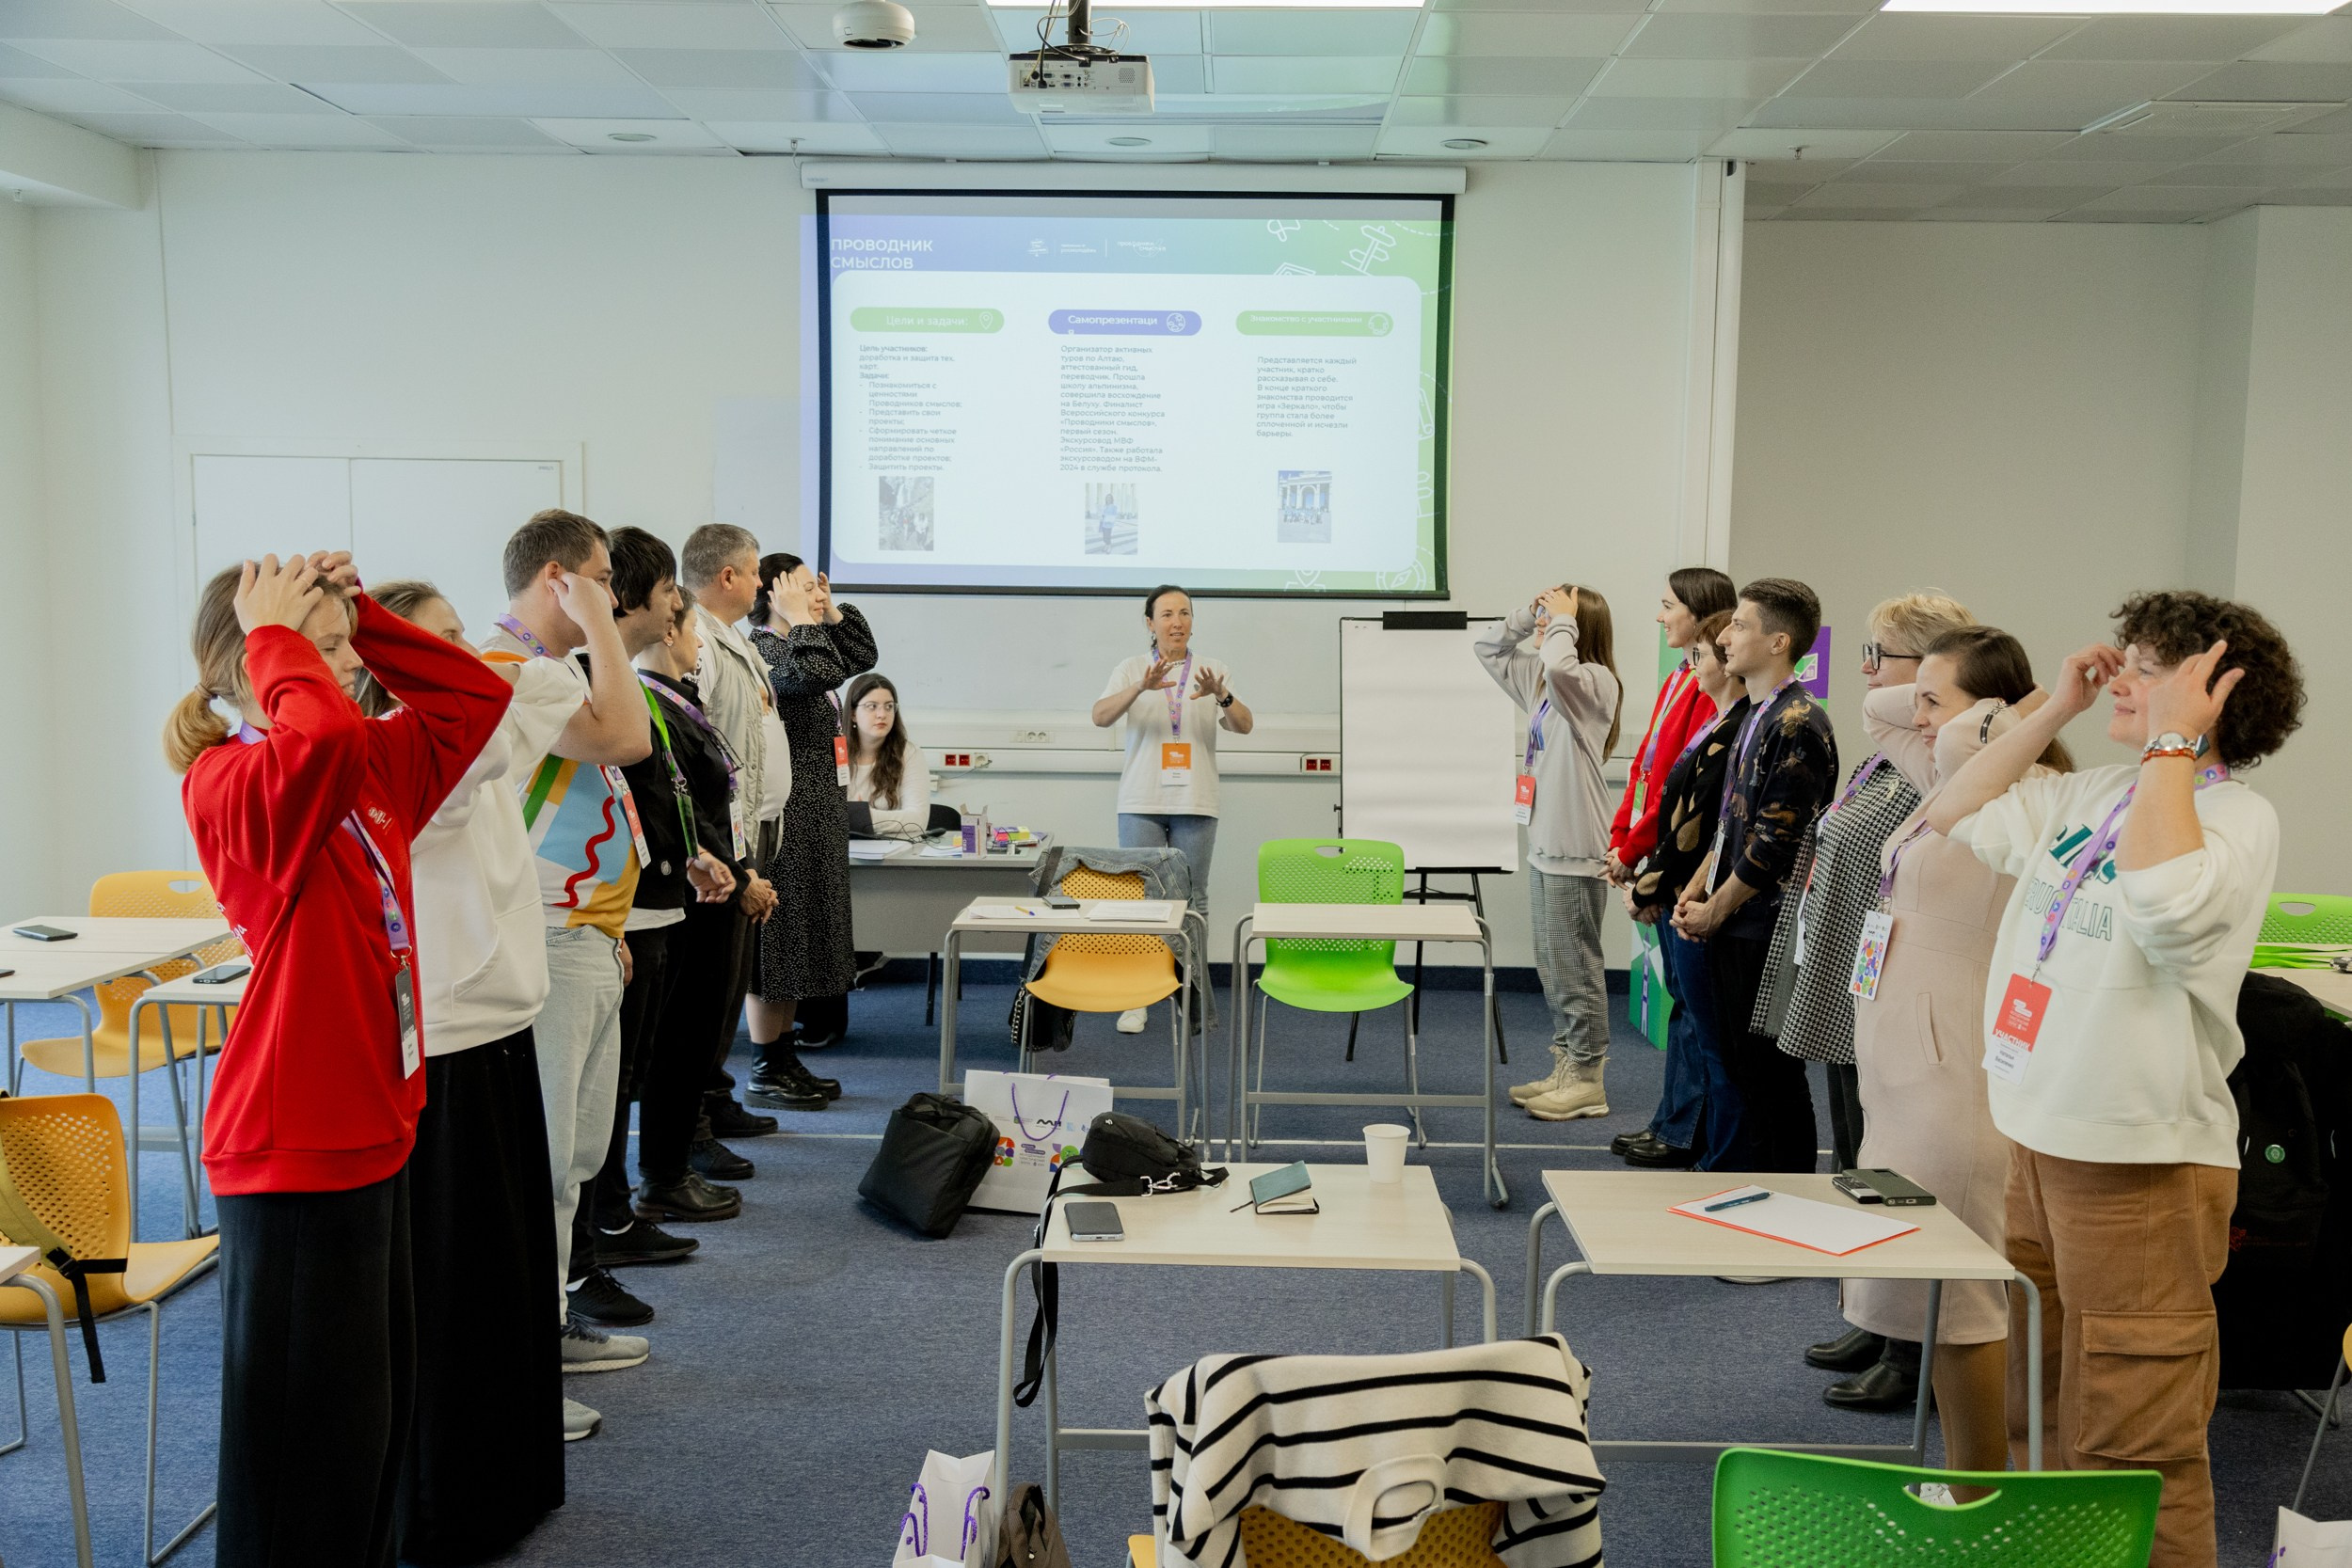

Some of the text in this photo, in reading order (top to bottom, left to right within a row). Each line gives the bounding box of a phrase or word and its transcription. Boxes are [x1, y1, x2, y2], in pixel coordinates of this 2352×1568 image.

[831, 239, 933, 254] ПРОВОДНИК
[831, 256, 914, 270] СМЫСЛОВ
[886, 315, 915, 327] Цели
[928, 317, 969, 327] задачи:
[1069, 315, 1157, 325] Самопрезентаци
[1258, 356, 1323, 365] Представляется
[868, 427, 929, 436] Сформировать
[1995, 1028, 2030, 1051] УЧАСТНИК
